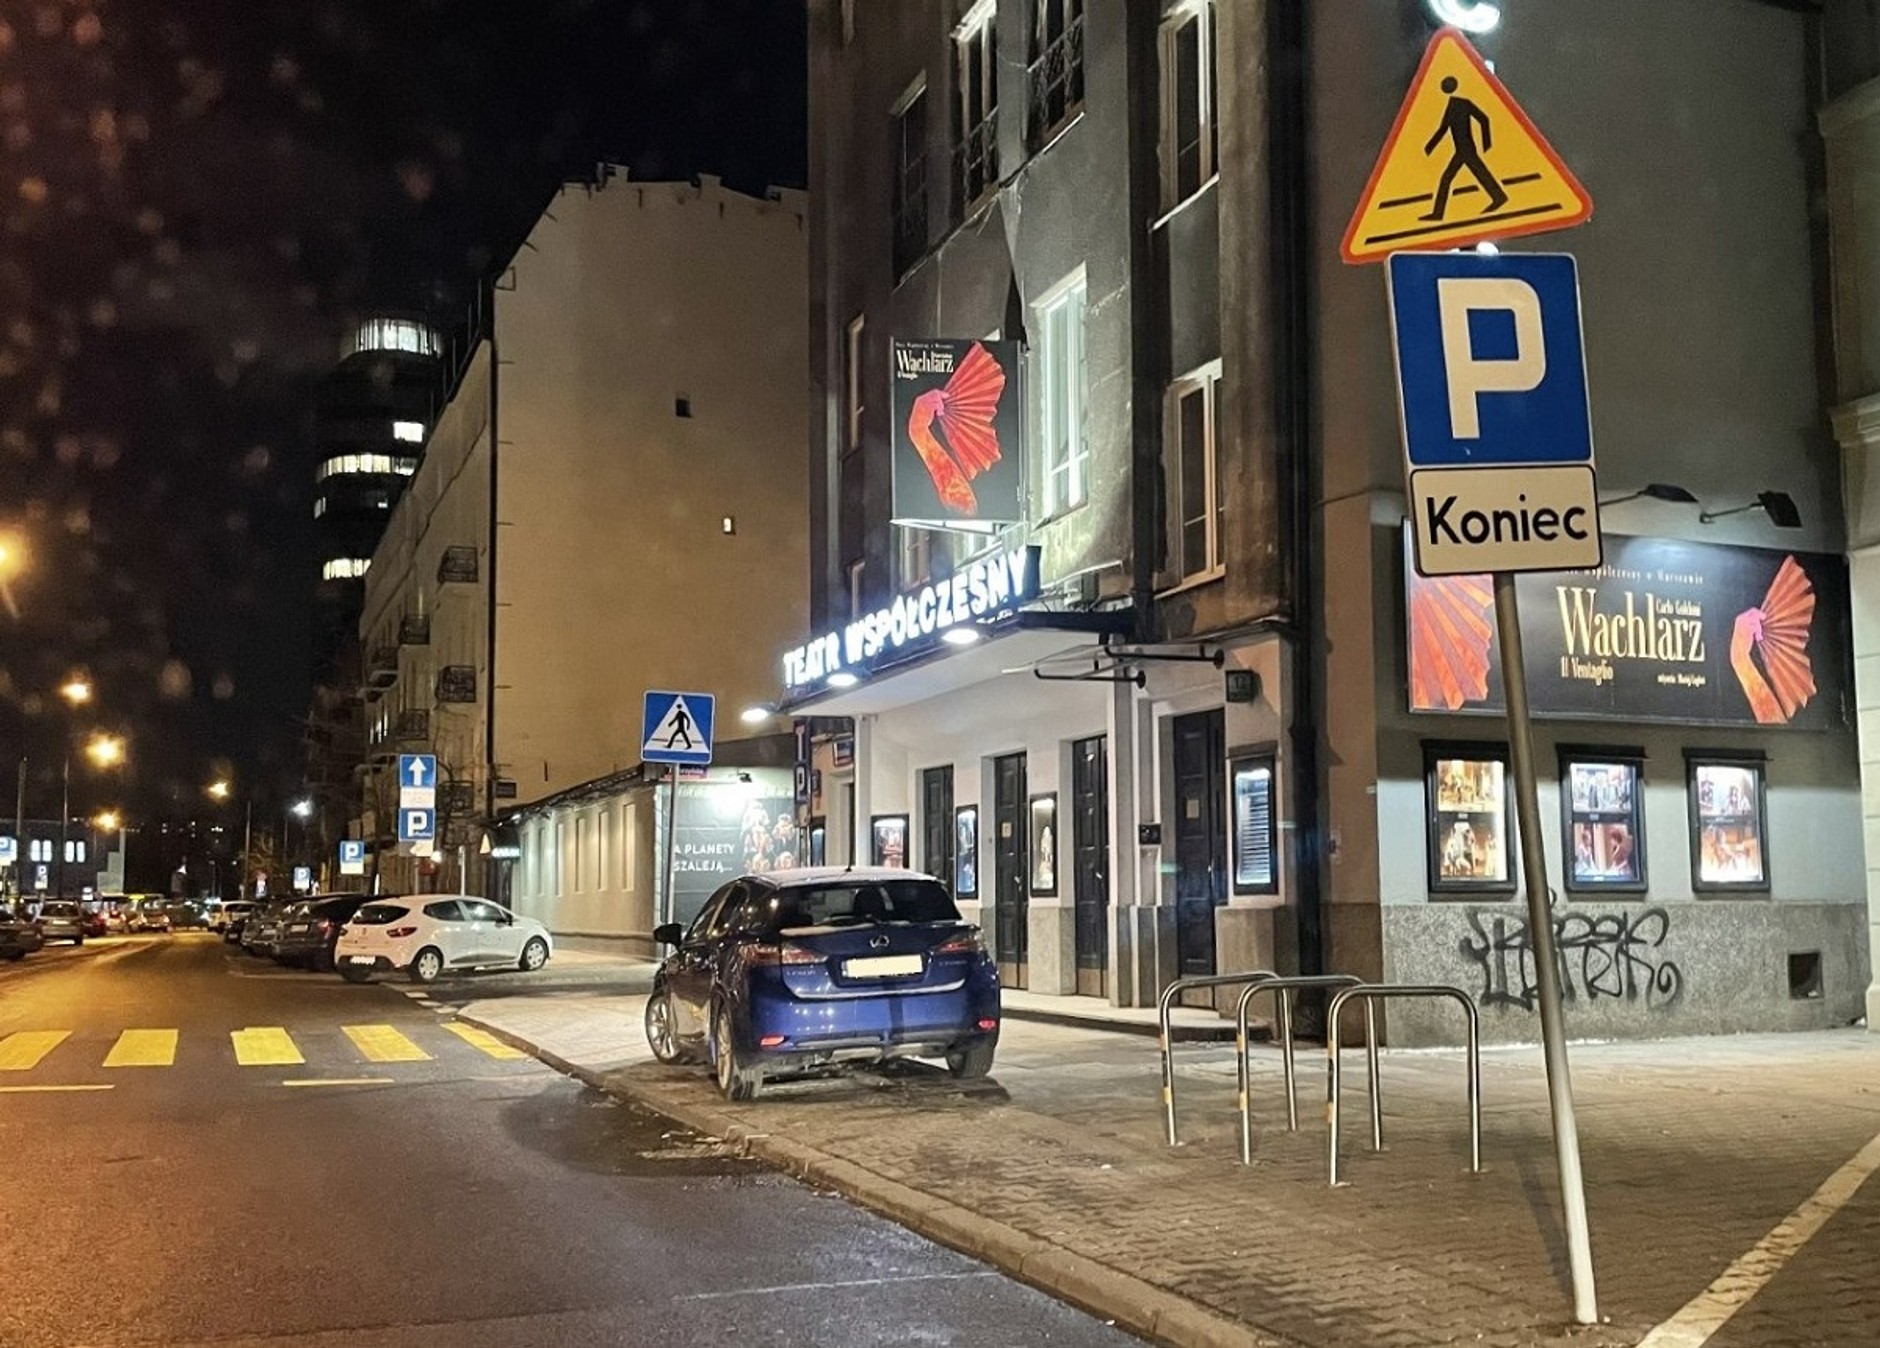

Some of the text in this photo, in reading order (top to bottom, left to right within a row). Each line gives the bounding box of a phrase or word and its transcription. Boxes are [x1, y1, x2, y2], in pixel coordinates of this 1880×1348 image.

[896, 349, 954, 373] Wachlarz
[1437, 278, 1546, 439] P
[1426, 494, 1588, 545] Koniec
[783, 546, 1028, 687] TEATR WSPÓŁCZESNY
[1556, 586, 1705, 662] Wachlarz
[407, 811, 428, 837] P
[345, 843, 358, 861] P
[684, 843, 735, 855] PLANETY
